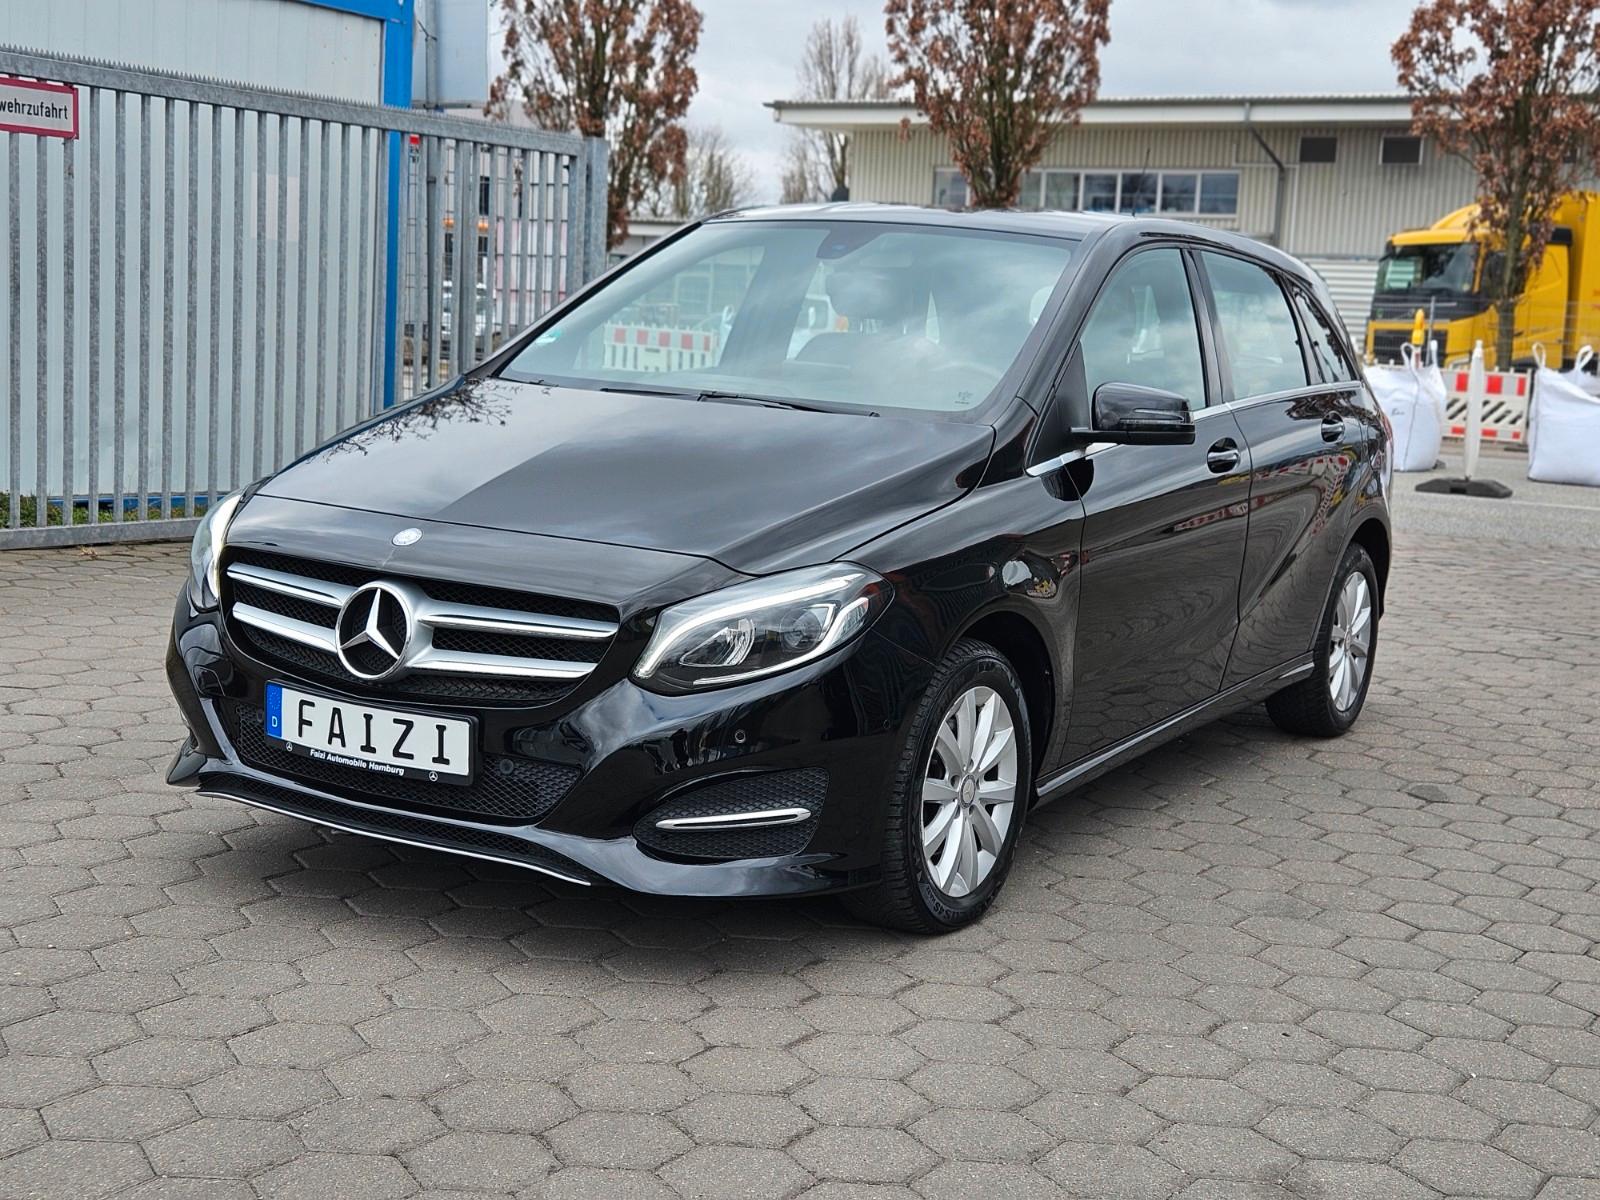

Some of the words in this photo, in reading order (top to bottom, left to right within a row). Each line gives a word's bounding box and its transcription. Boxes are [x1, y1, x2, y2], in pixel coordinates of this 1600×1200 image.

[0, 97, 68, 120] wehrzufahrt
[271, 715, 278, 728] D
[298, 699, 450, 766] FAIZI
[310, 749, 326, 760] Faizi
[327, 754, 367, 768] Automobile
[368, 762, 405, 776] Hamburg
